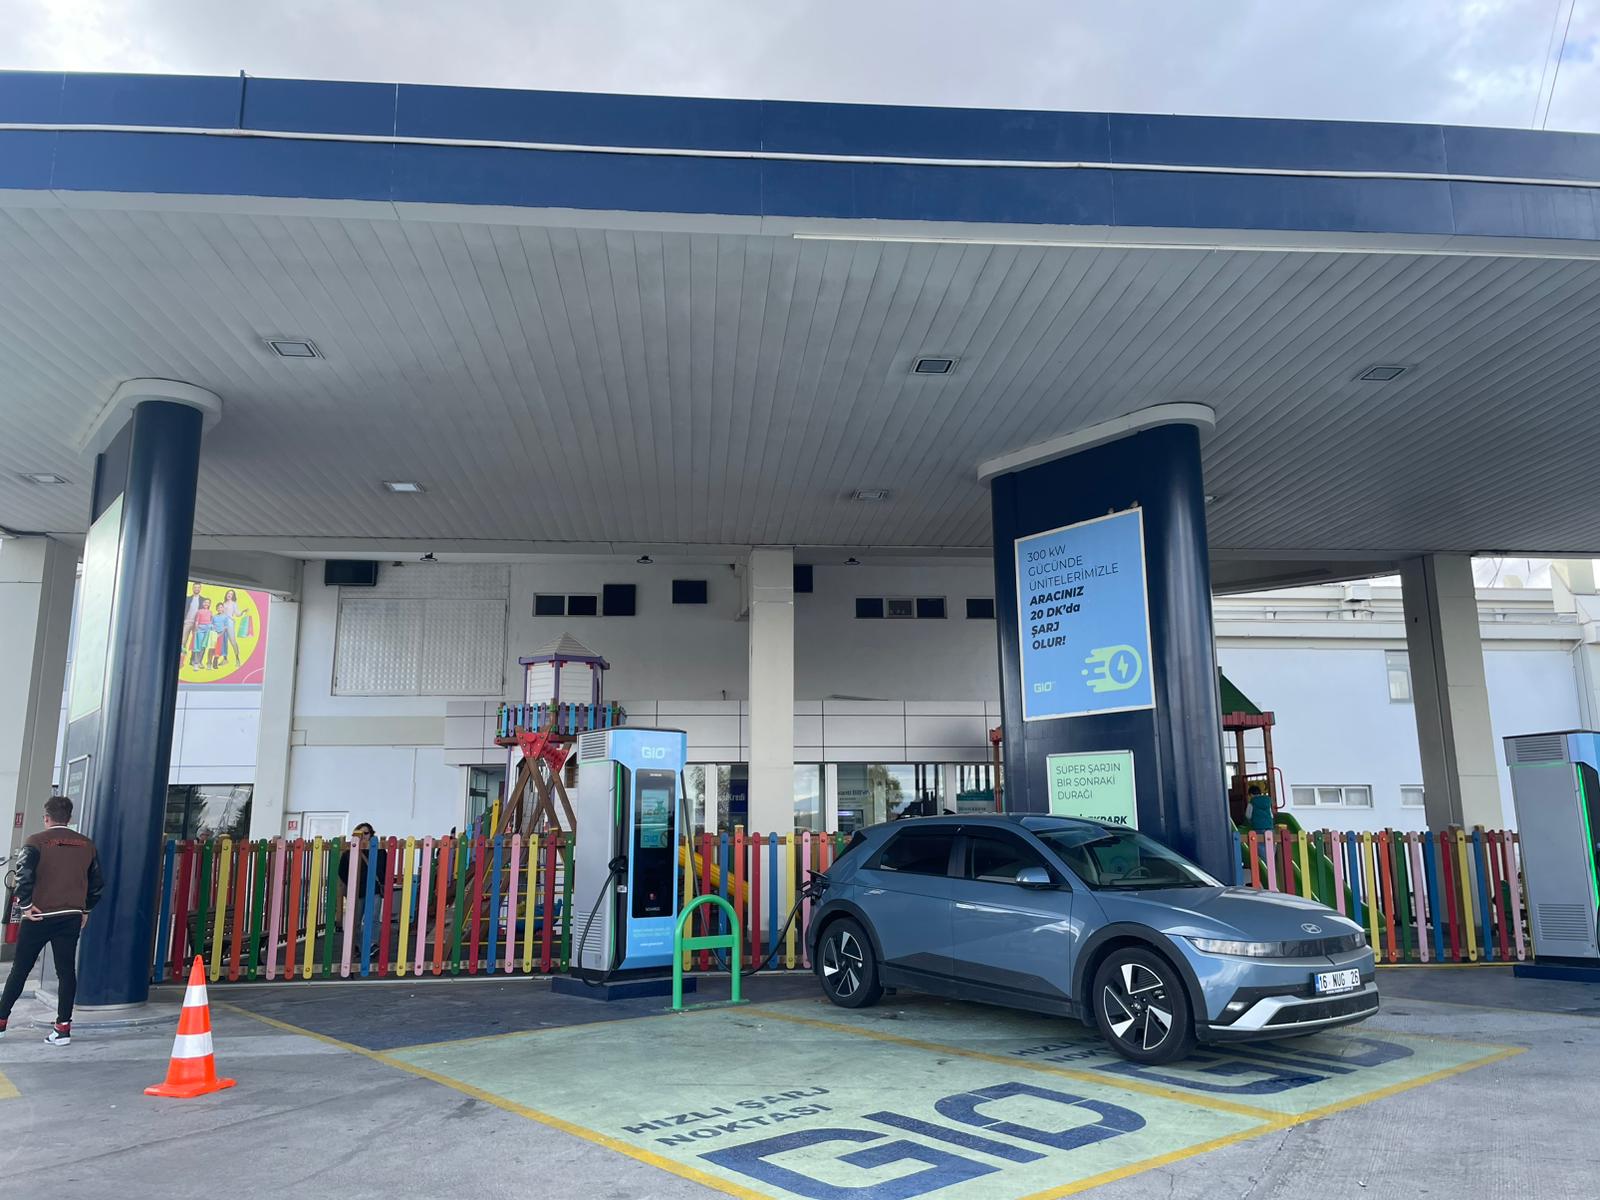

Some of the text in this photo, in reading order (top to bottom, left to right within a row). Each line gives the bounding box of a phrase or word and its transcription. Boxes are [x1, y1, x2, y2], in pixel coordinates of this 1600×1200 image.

[1027, 545, 1066, 562] 300 kW
[1028, 555, 1083, 576] GÜCÜNDE
[1029, 562, 1119, 591] ÜNİTELERİMİZLE
[1029, 586, 1084, 606] ARACINIZ
[1030, 603, 1081, 620] 20 DK'da
[1031, 621, 1060, 638] ŞARJ
[1032, 635, 1067, 650] OLUR!
[1074, 776, 1116, 787] SONRAKİ
[1057, 789, 1093, 800] DURAĞI
[1319, 970, 1359, 989] 16 NUG 26
[620, 1106, 733, 1134] HIZLI
[654, 1103, 834, 1146] NOKTASI
[696, 1081, 1146, 1200] GIO
